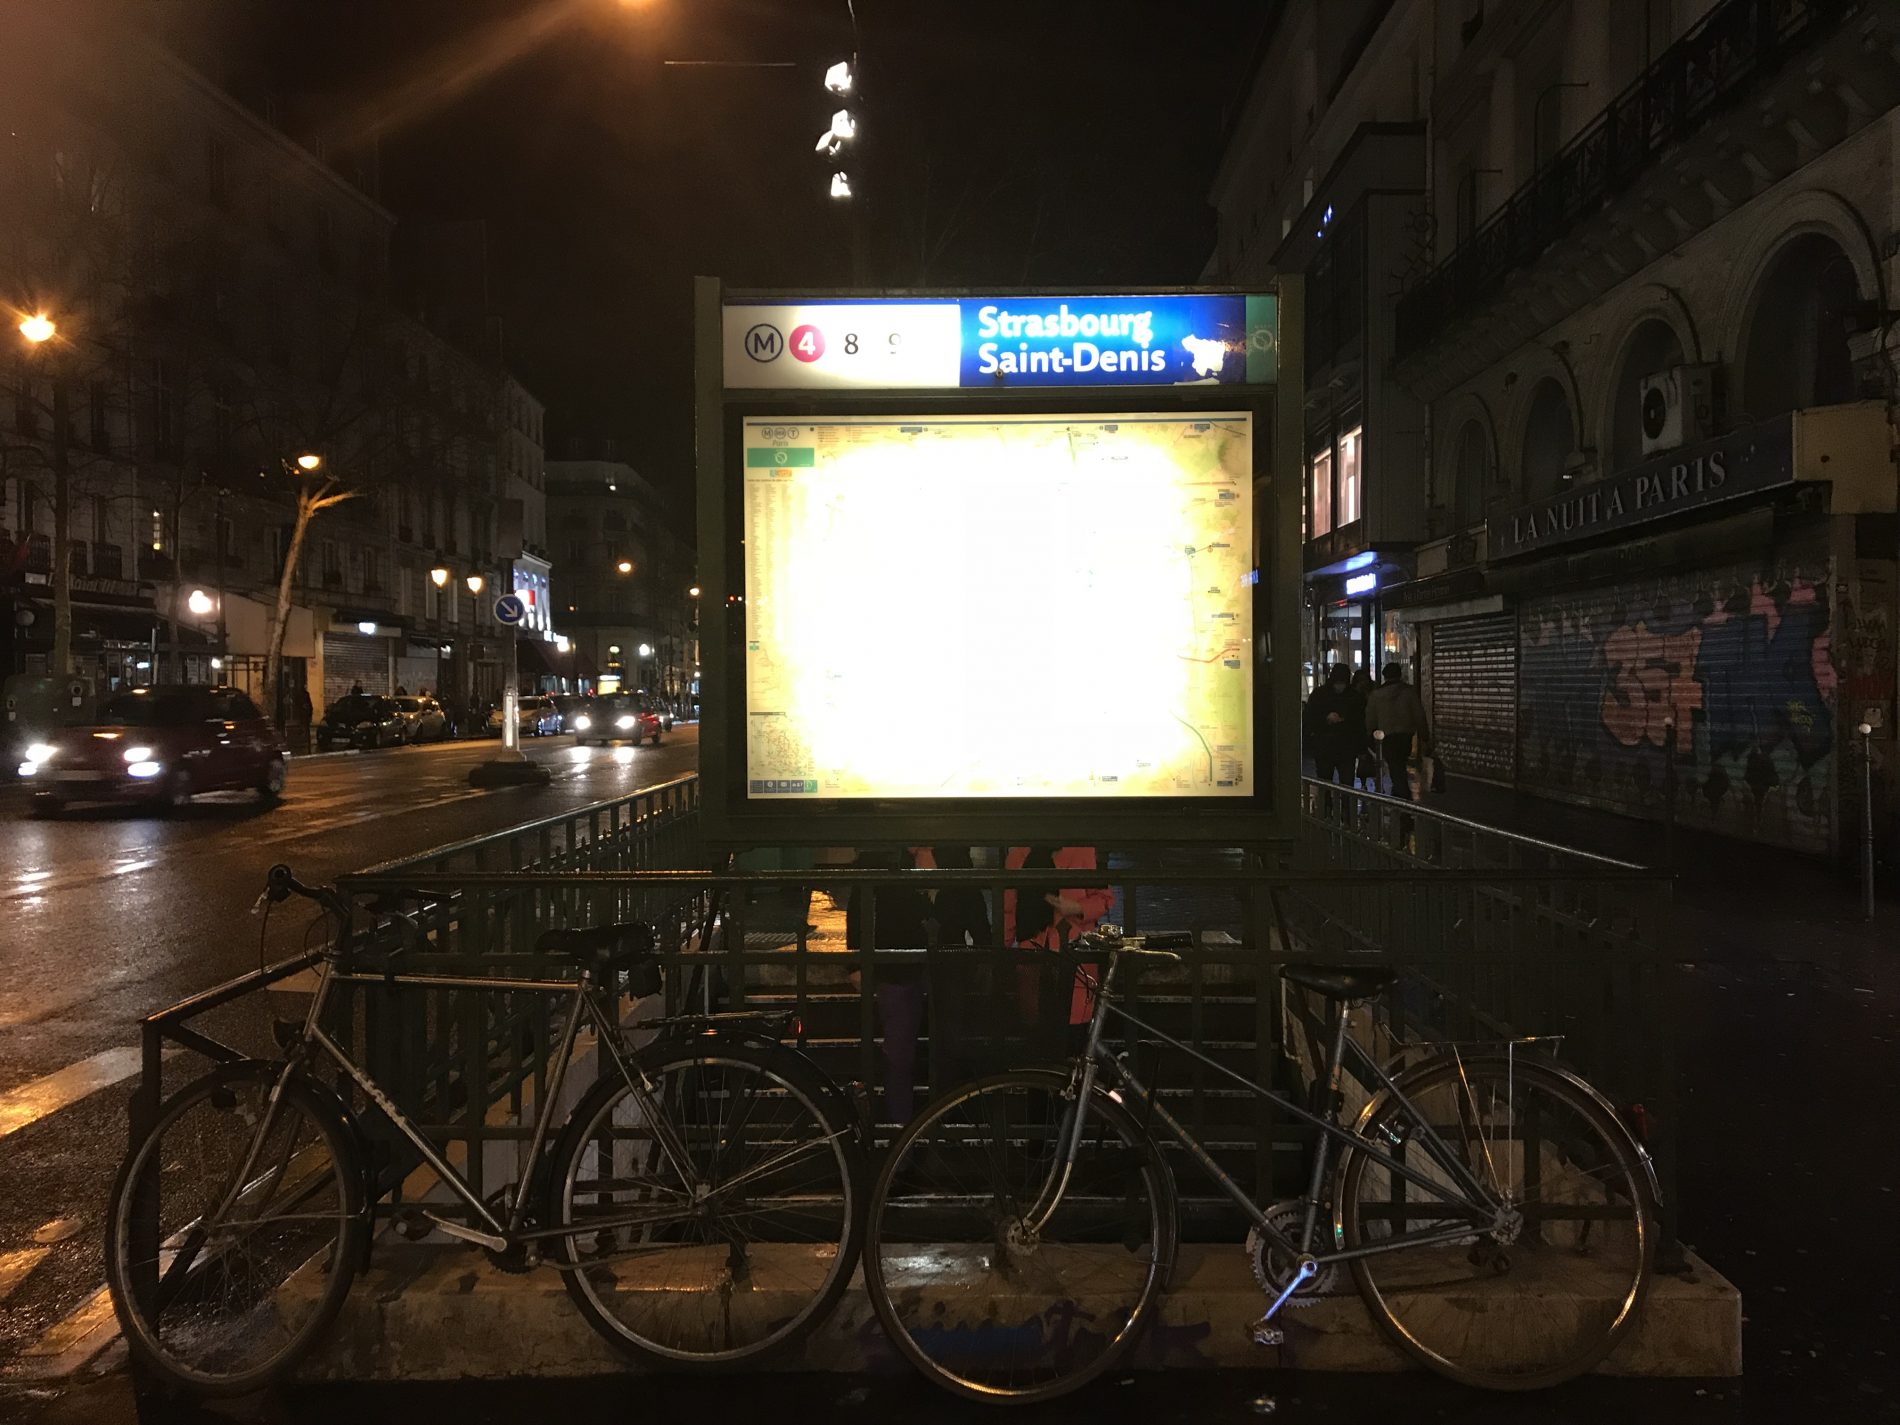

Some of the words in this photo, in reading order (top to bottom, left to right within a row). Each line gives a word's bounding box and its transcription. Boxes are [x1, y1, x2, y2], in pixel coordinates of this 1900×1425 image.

[798, 331, 817, 355] 4
[843, 333, 859, 355] 8
[978, 304, 1153, 348] Strasbourg
[978, 342, 1166, 374] Saint-Denis
[1514, 514, 1538, 544] LA
[1547, 492, 1601, 535] NUIT
[1636, 451, 1726, 510] PARIS
